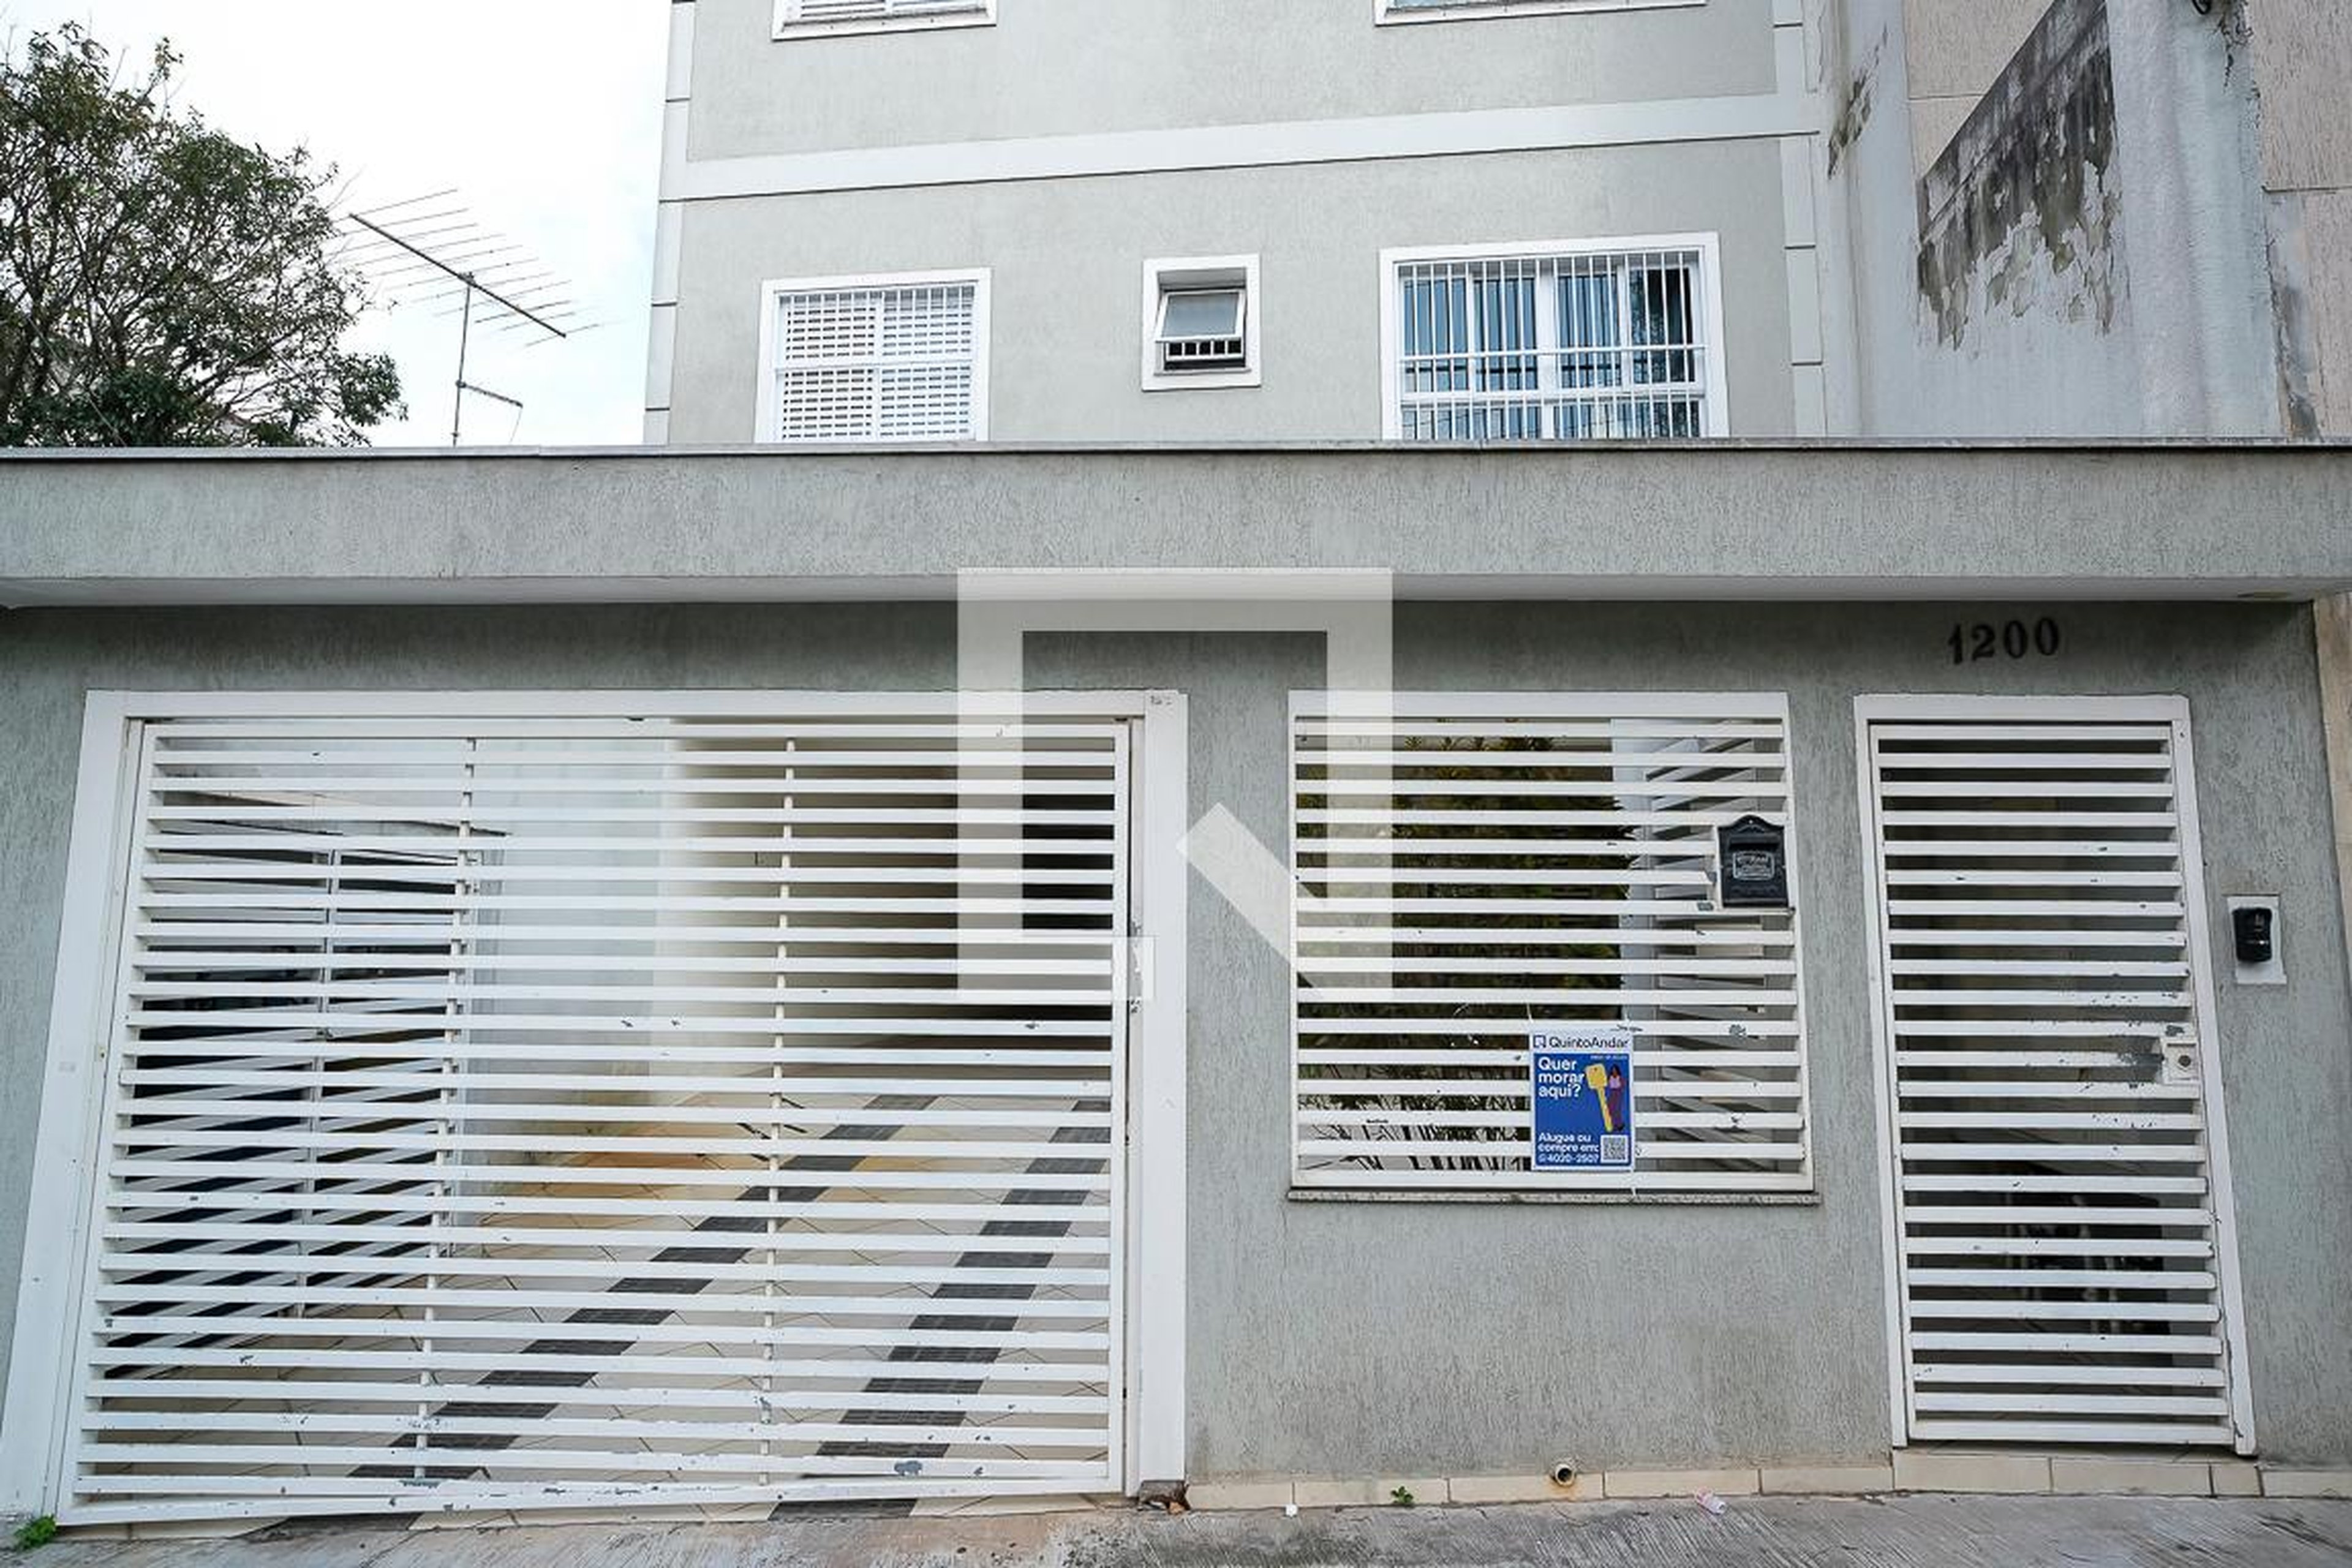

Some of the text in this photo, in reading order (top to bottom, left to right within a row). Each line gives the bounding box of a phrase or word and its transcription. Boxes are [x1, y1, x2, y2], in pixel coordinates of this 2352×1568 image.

[1948, 617, 2059, 665] 1200
[1548, 1036, 1629, 1049] QuintoAndar
[1537, 1056, 1577, 1071] Quer
[1538, 1073, 1585, 1084] morar
[1538, 1085, 1581, 1099] aqui?
[1538, 1133, 1575, 1144] Alugue
